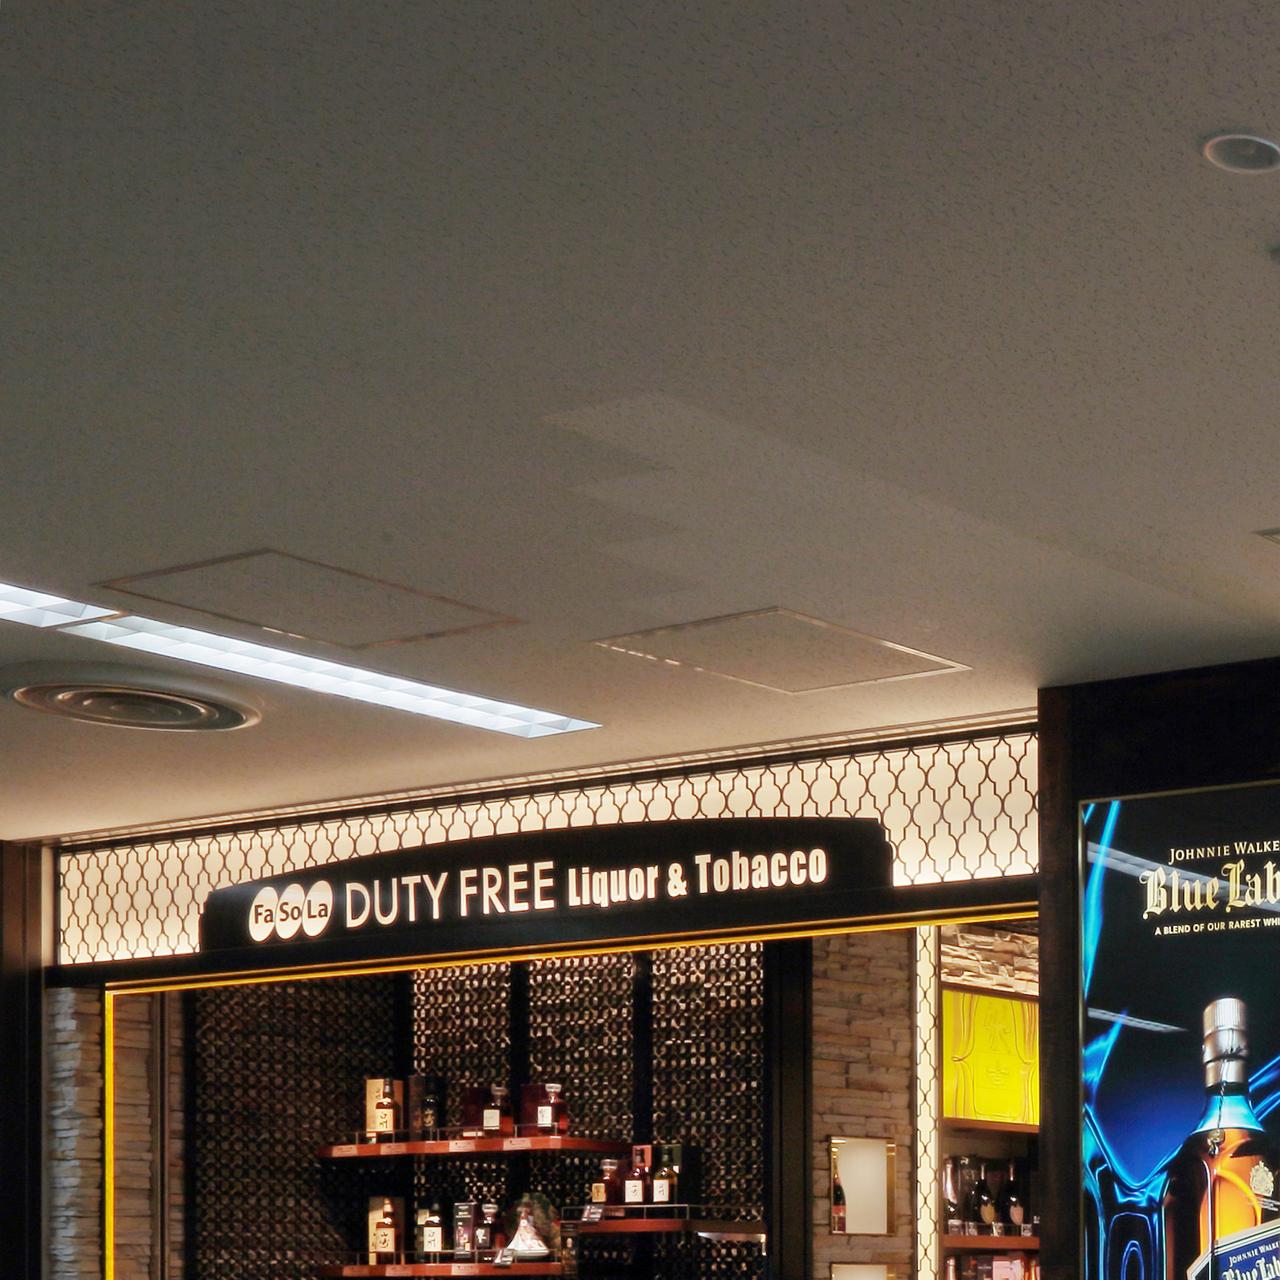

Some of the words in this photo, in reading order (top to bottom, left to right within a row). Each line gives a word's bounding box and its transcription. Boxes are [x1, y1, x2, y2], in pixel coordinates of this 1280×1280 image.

[1168, 845, 1230, 865] JOHNNIE
[346, 872, 448, 928] DUTY
[460, 861, 555, 917] FREE
[568, 864, 659, 908] Liquor
[667, 863, 688, 897] &
[695, 848, 827, 894] Tobacco
[1138, 866, 1220, 920] Blue
[1154, 926, 1162, 936] A
[1163, 924, 1191, 935] BLEND
[1192, 923, 1205, 933] OF
[1207, 921, 1225, 932] OUR
[1228, 919, 1261, 930] RAREST
[1228, 1248, 1258, 1267] JOHNNIE
